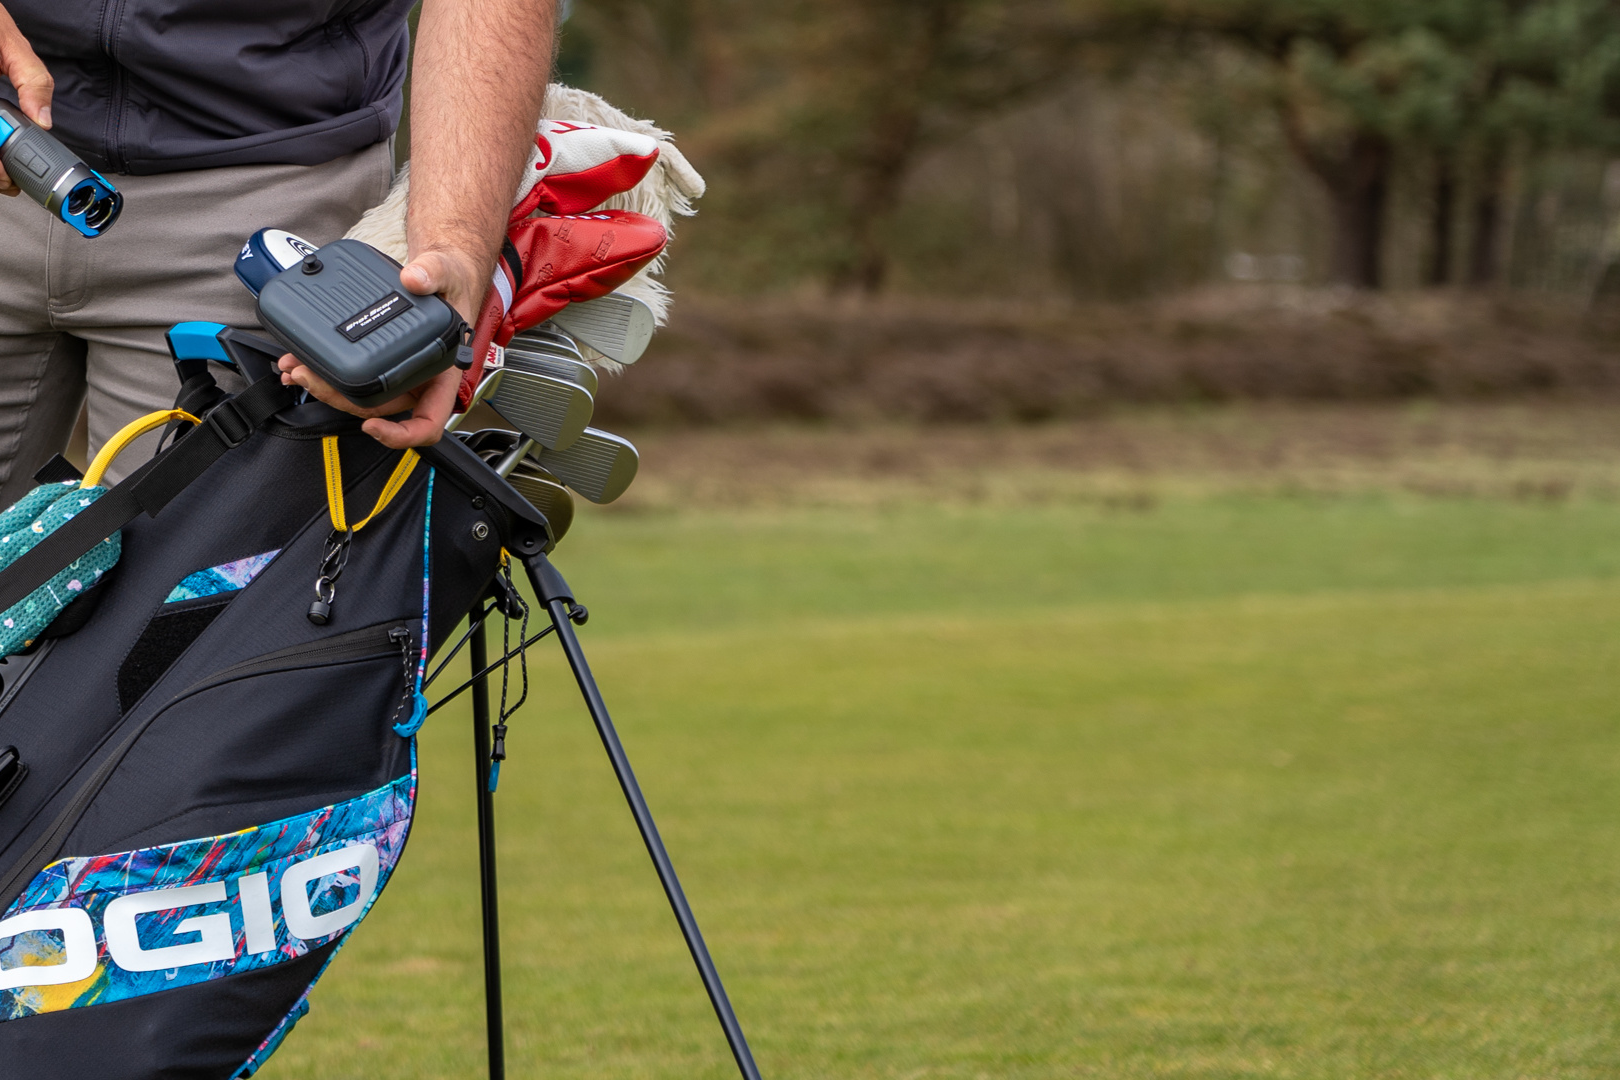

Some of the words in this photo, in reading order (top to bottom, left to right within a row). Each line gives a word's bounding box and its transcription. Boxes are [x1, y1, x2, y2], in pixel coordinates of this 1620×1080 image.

[241, 239, 254, 260] EY
[345, 314, 369, 332] Shot
[369, 296, 399, 317] Scope
